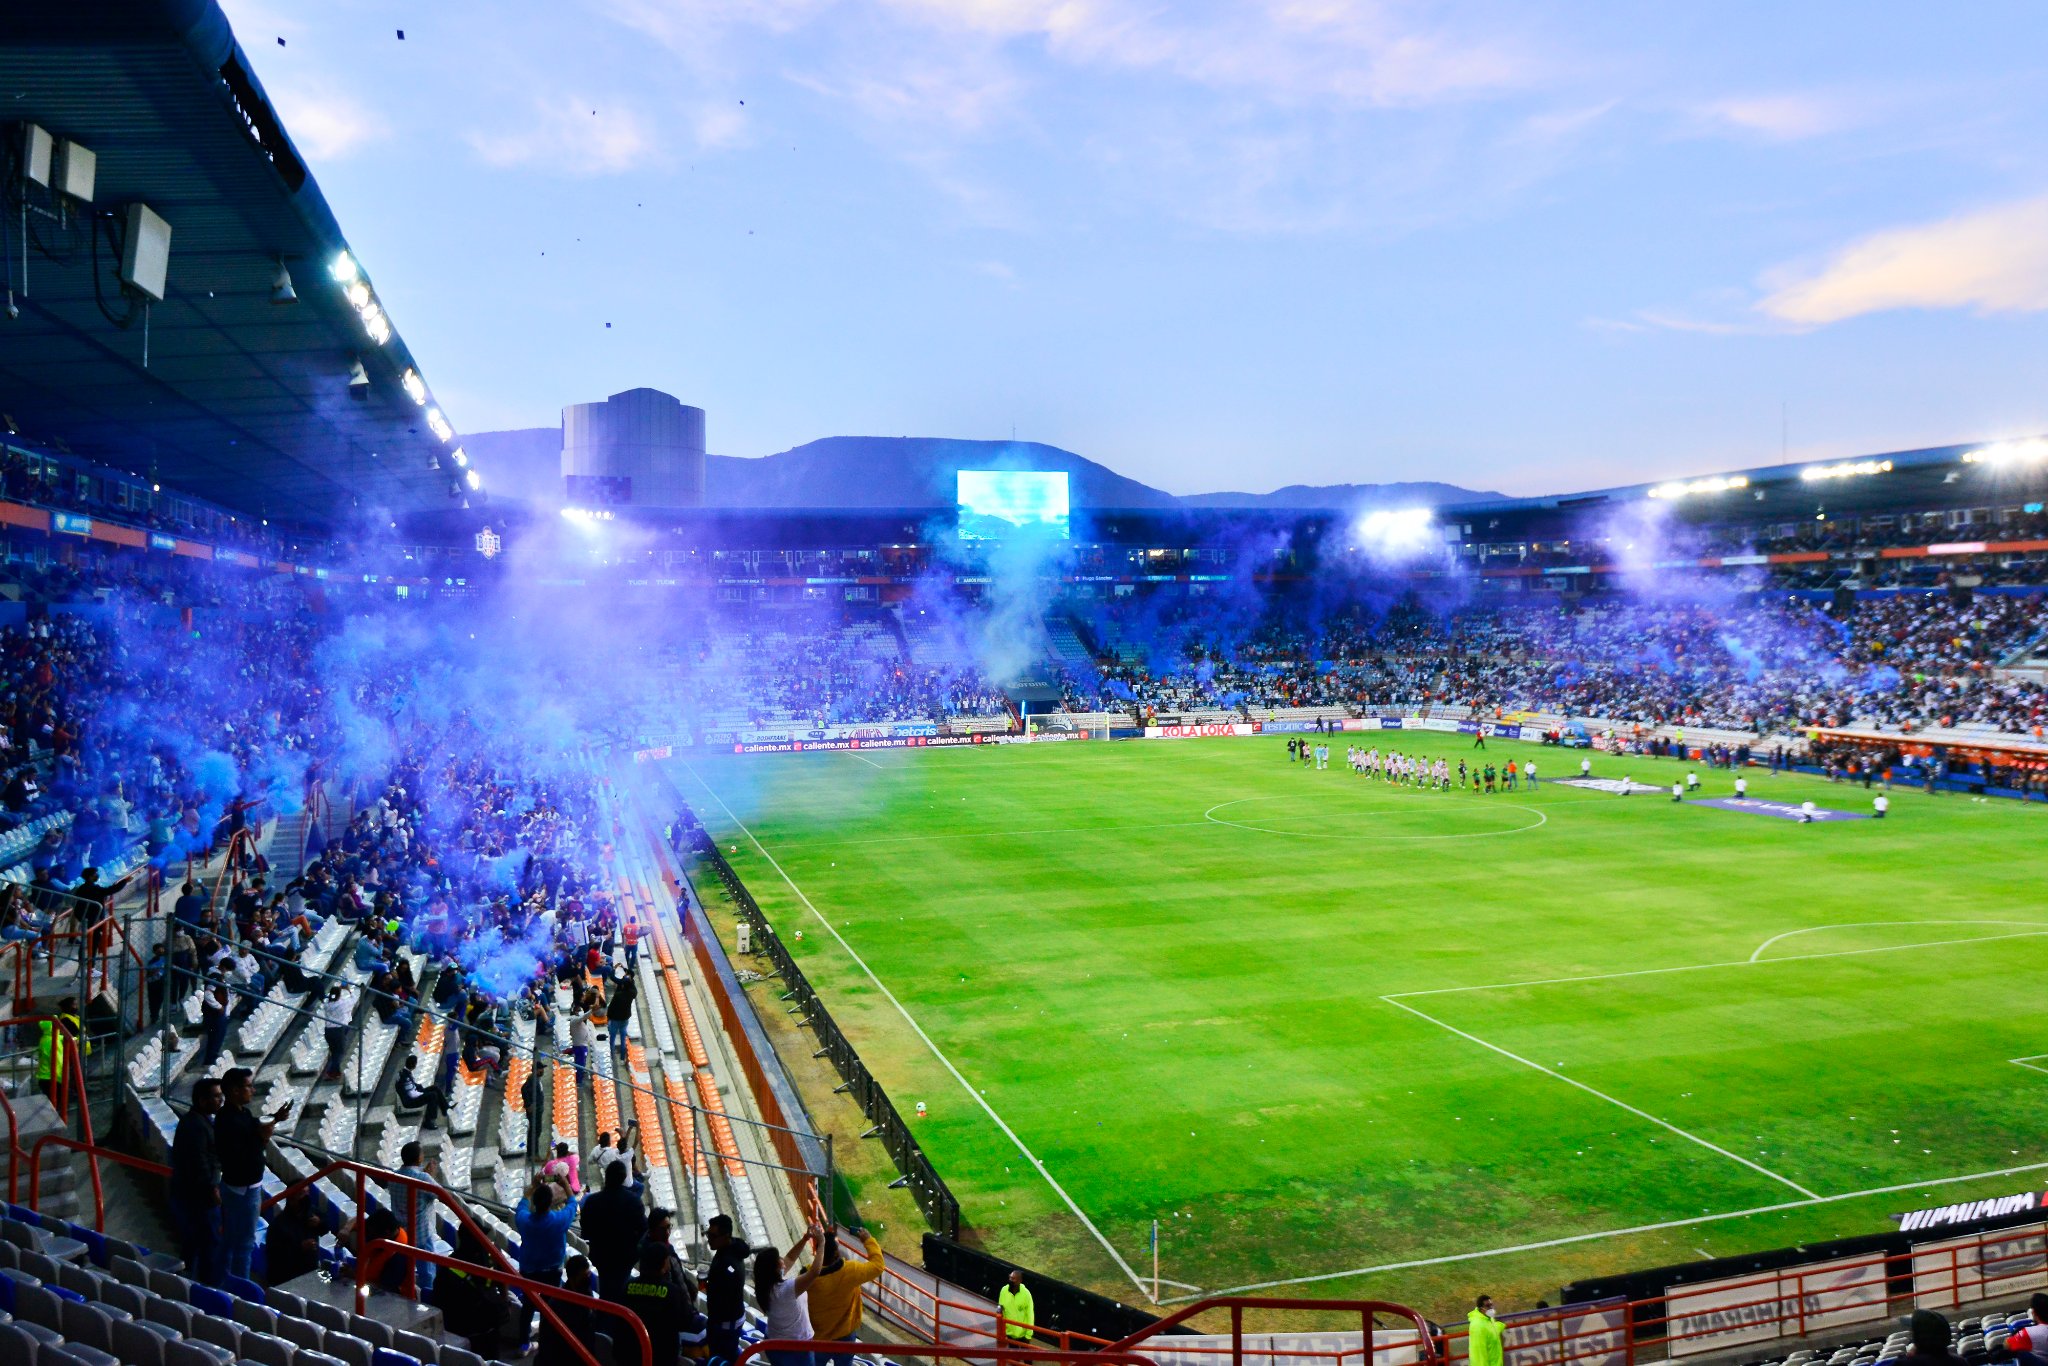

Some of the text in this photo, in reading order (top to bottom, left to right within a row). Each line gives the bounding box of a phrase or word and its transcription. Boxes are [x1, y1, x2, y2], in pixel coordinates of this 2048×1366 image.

[1162, 724, 1236, 737] KOLA LOKA
[744, 744, 792, 752] caliente.mx
[803, 741, 849, 750] caliente.mx
[860, 739, 906, 748] caliente.mx
[927, 736, 972, 745] caliente.mx
[627, 1283, 668, 1298] SEGURIDAD
